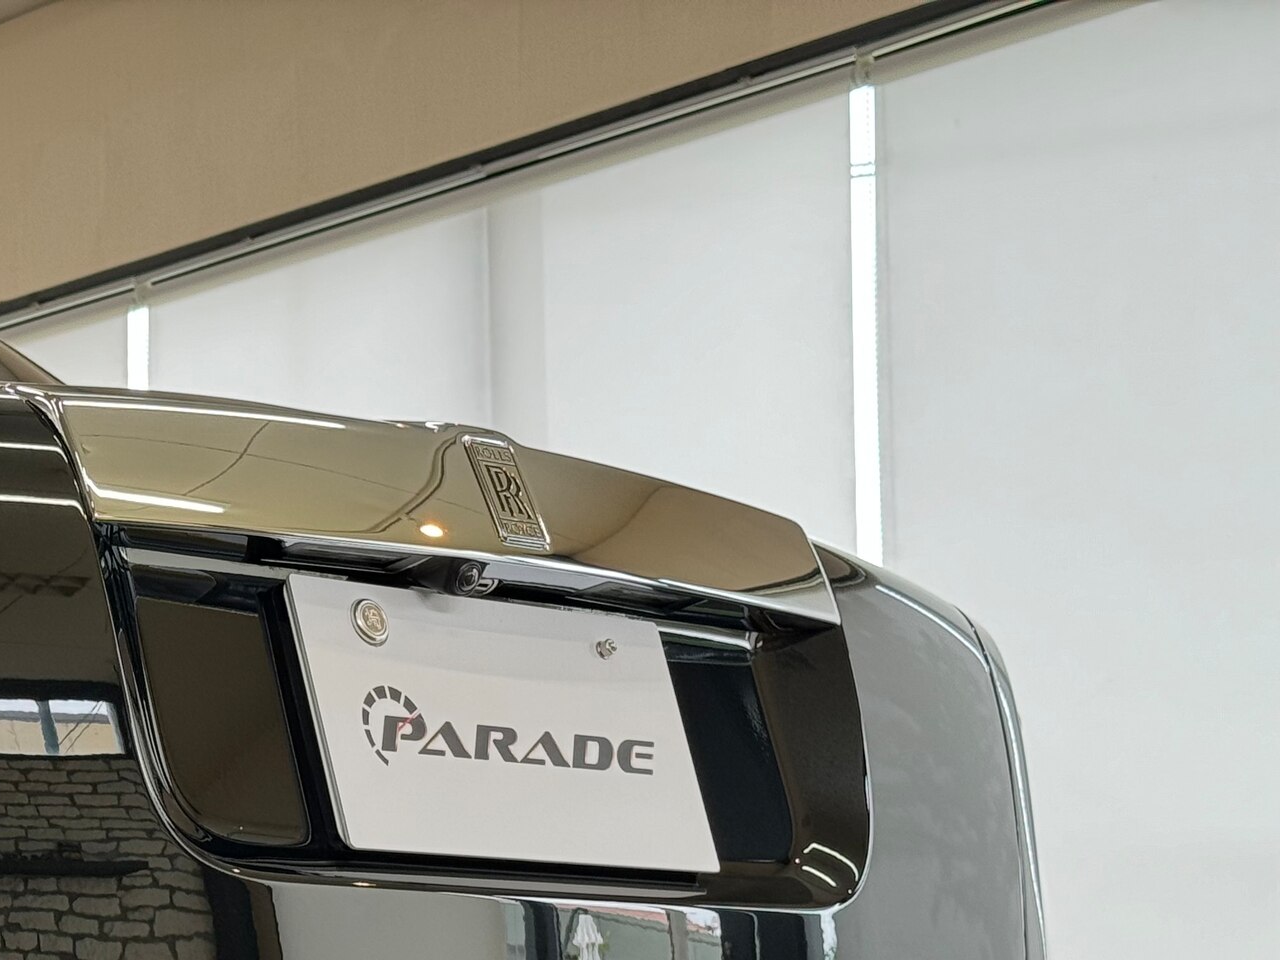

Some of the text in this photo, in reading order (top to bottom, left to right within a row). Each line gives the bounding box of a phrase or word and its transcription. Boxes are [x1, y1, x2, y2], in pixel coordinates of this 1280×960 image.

[476, 447, 512, 462] ROLLS
[503, 522, 542, 537] ROYCE
[381, 713, 655, 776] PARADE
